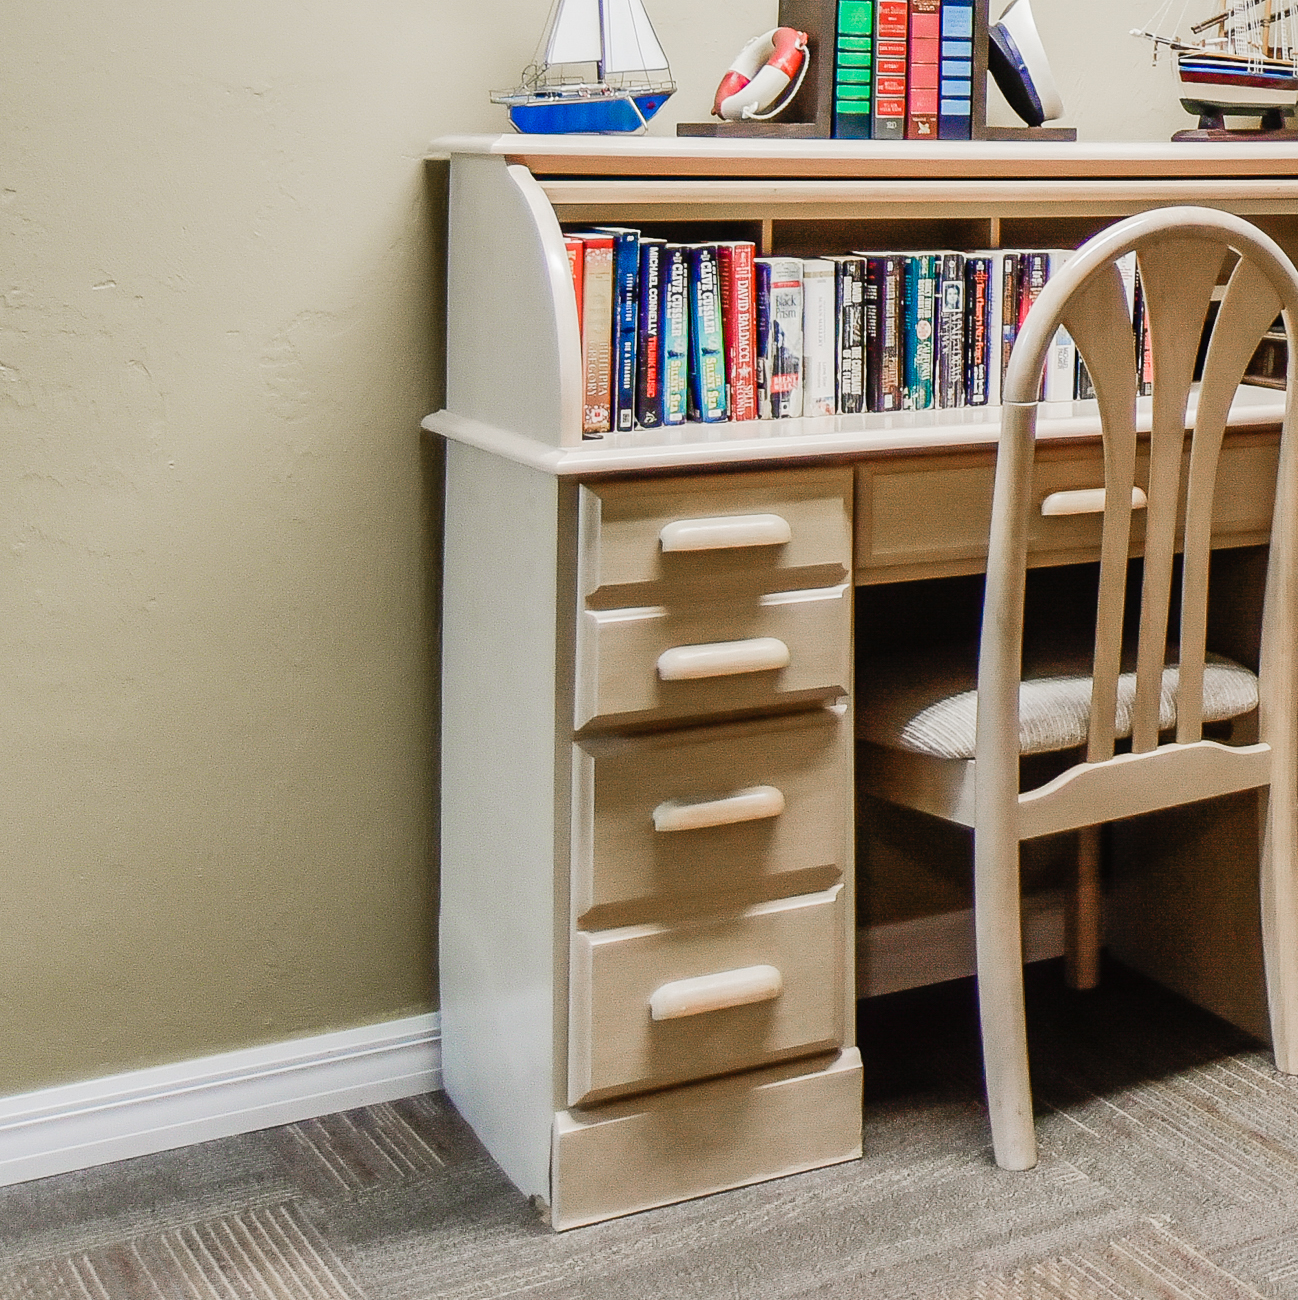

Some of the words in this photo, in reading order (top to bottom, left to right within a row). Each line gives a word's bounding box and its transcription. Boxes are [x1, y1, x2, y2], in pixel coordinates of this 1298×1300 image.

[648, 246, 659, 288] MICHAEL
[671, 263, 684, 292] CLIVE
[648, 288, 659, 336] CONNELLY
[737, 279, 749, 312] DAVID
[671, 294, 684, 337] CUSSLER
[647, 336, 658, 368] TRUNK
[737, 313, 750, 363] BALDACCI
[647, 369, 657, 398] MUSIC
